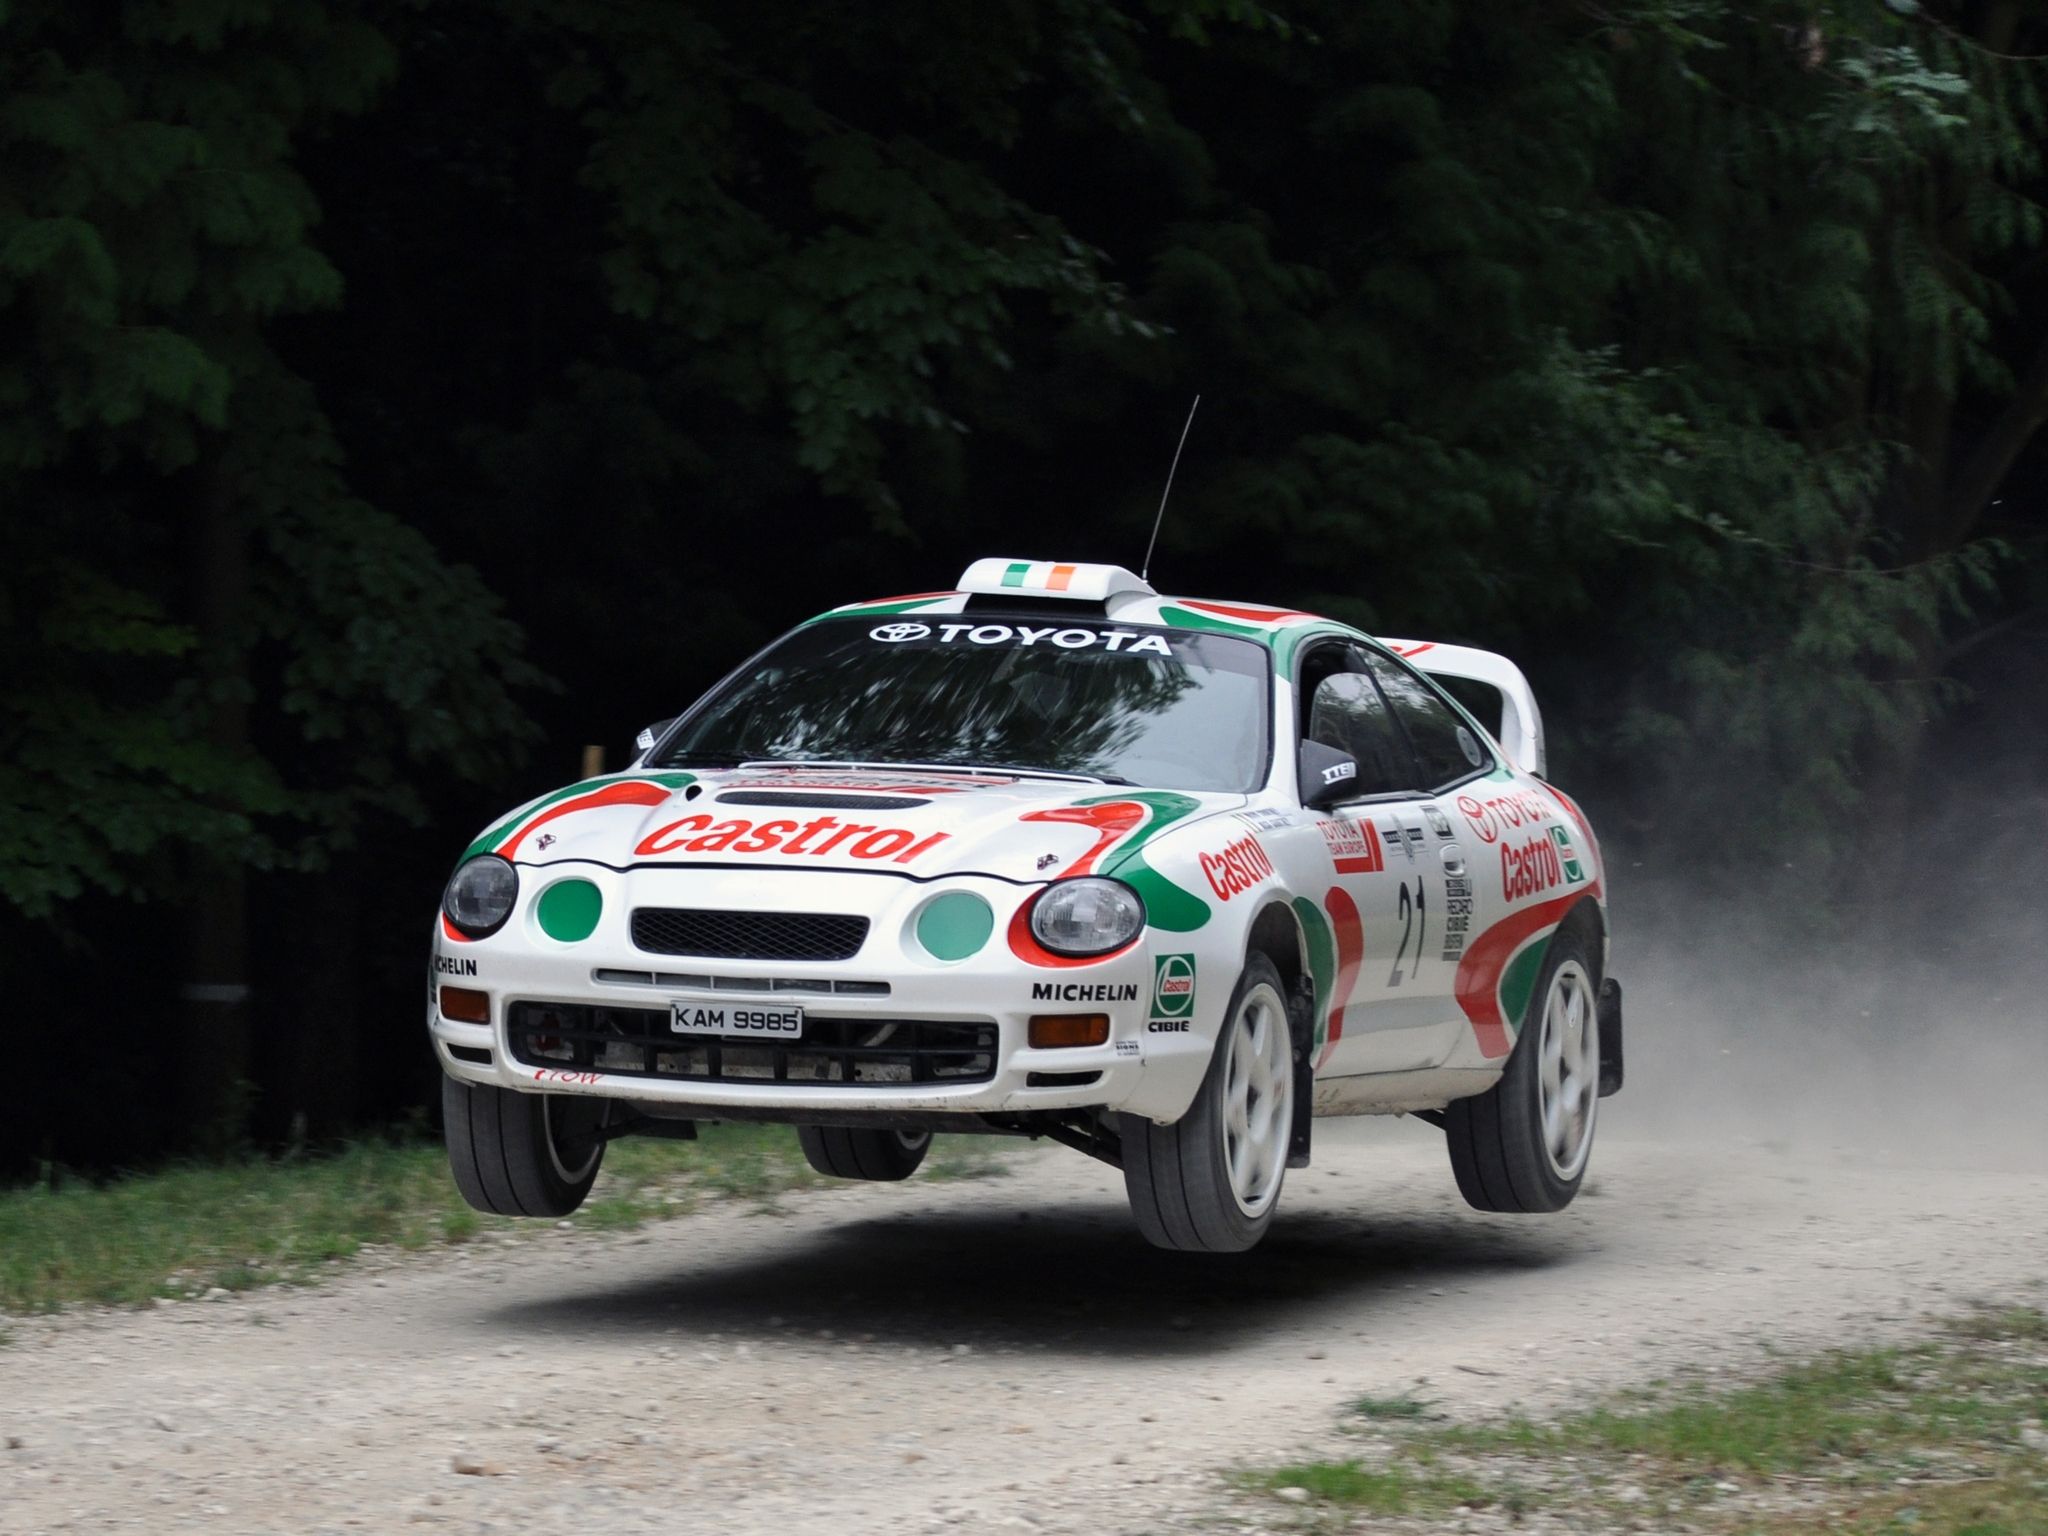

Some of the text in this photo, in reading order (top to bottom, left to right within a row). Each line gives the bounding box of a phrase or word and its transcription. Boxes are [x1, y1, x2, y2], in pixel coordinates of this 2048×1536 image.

[938, 624, 1173, 657] TOYOTA
[633, 814, 953, 865] Castrol
[1501, 827, 1562, 903] Castrol
[1198, 829, 1276, 902] Castrol
[1387, 875, 1425, 987] 21
[1032, 983, 1138, 1001] MICHELIN
[675, 1007, 799, 1032] KAM 9985
